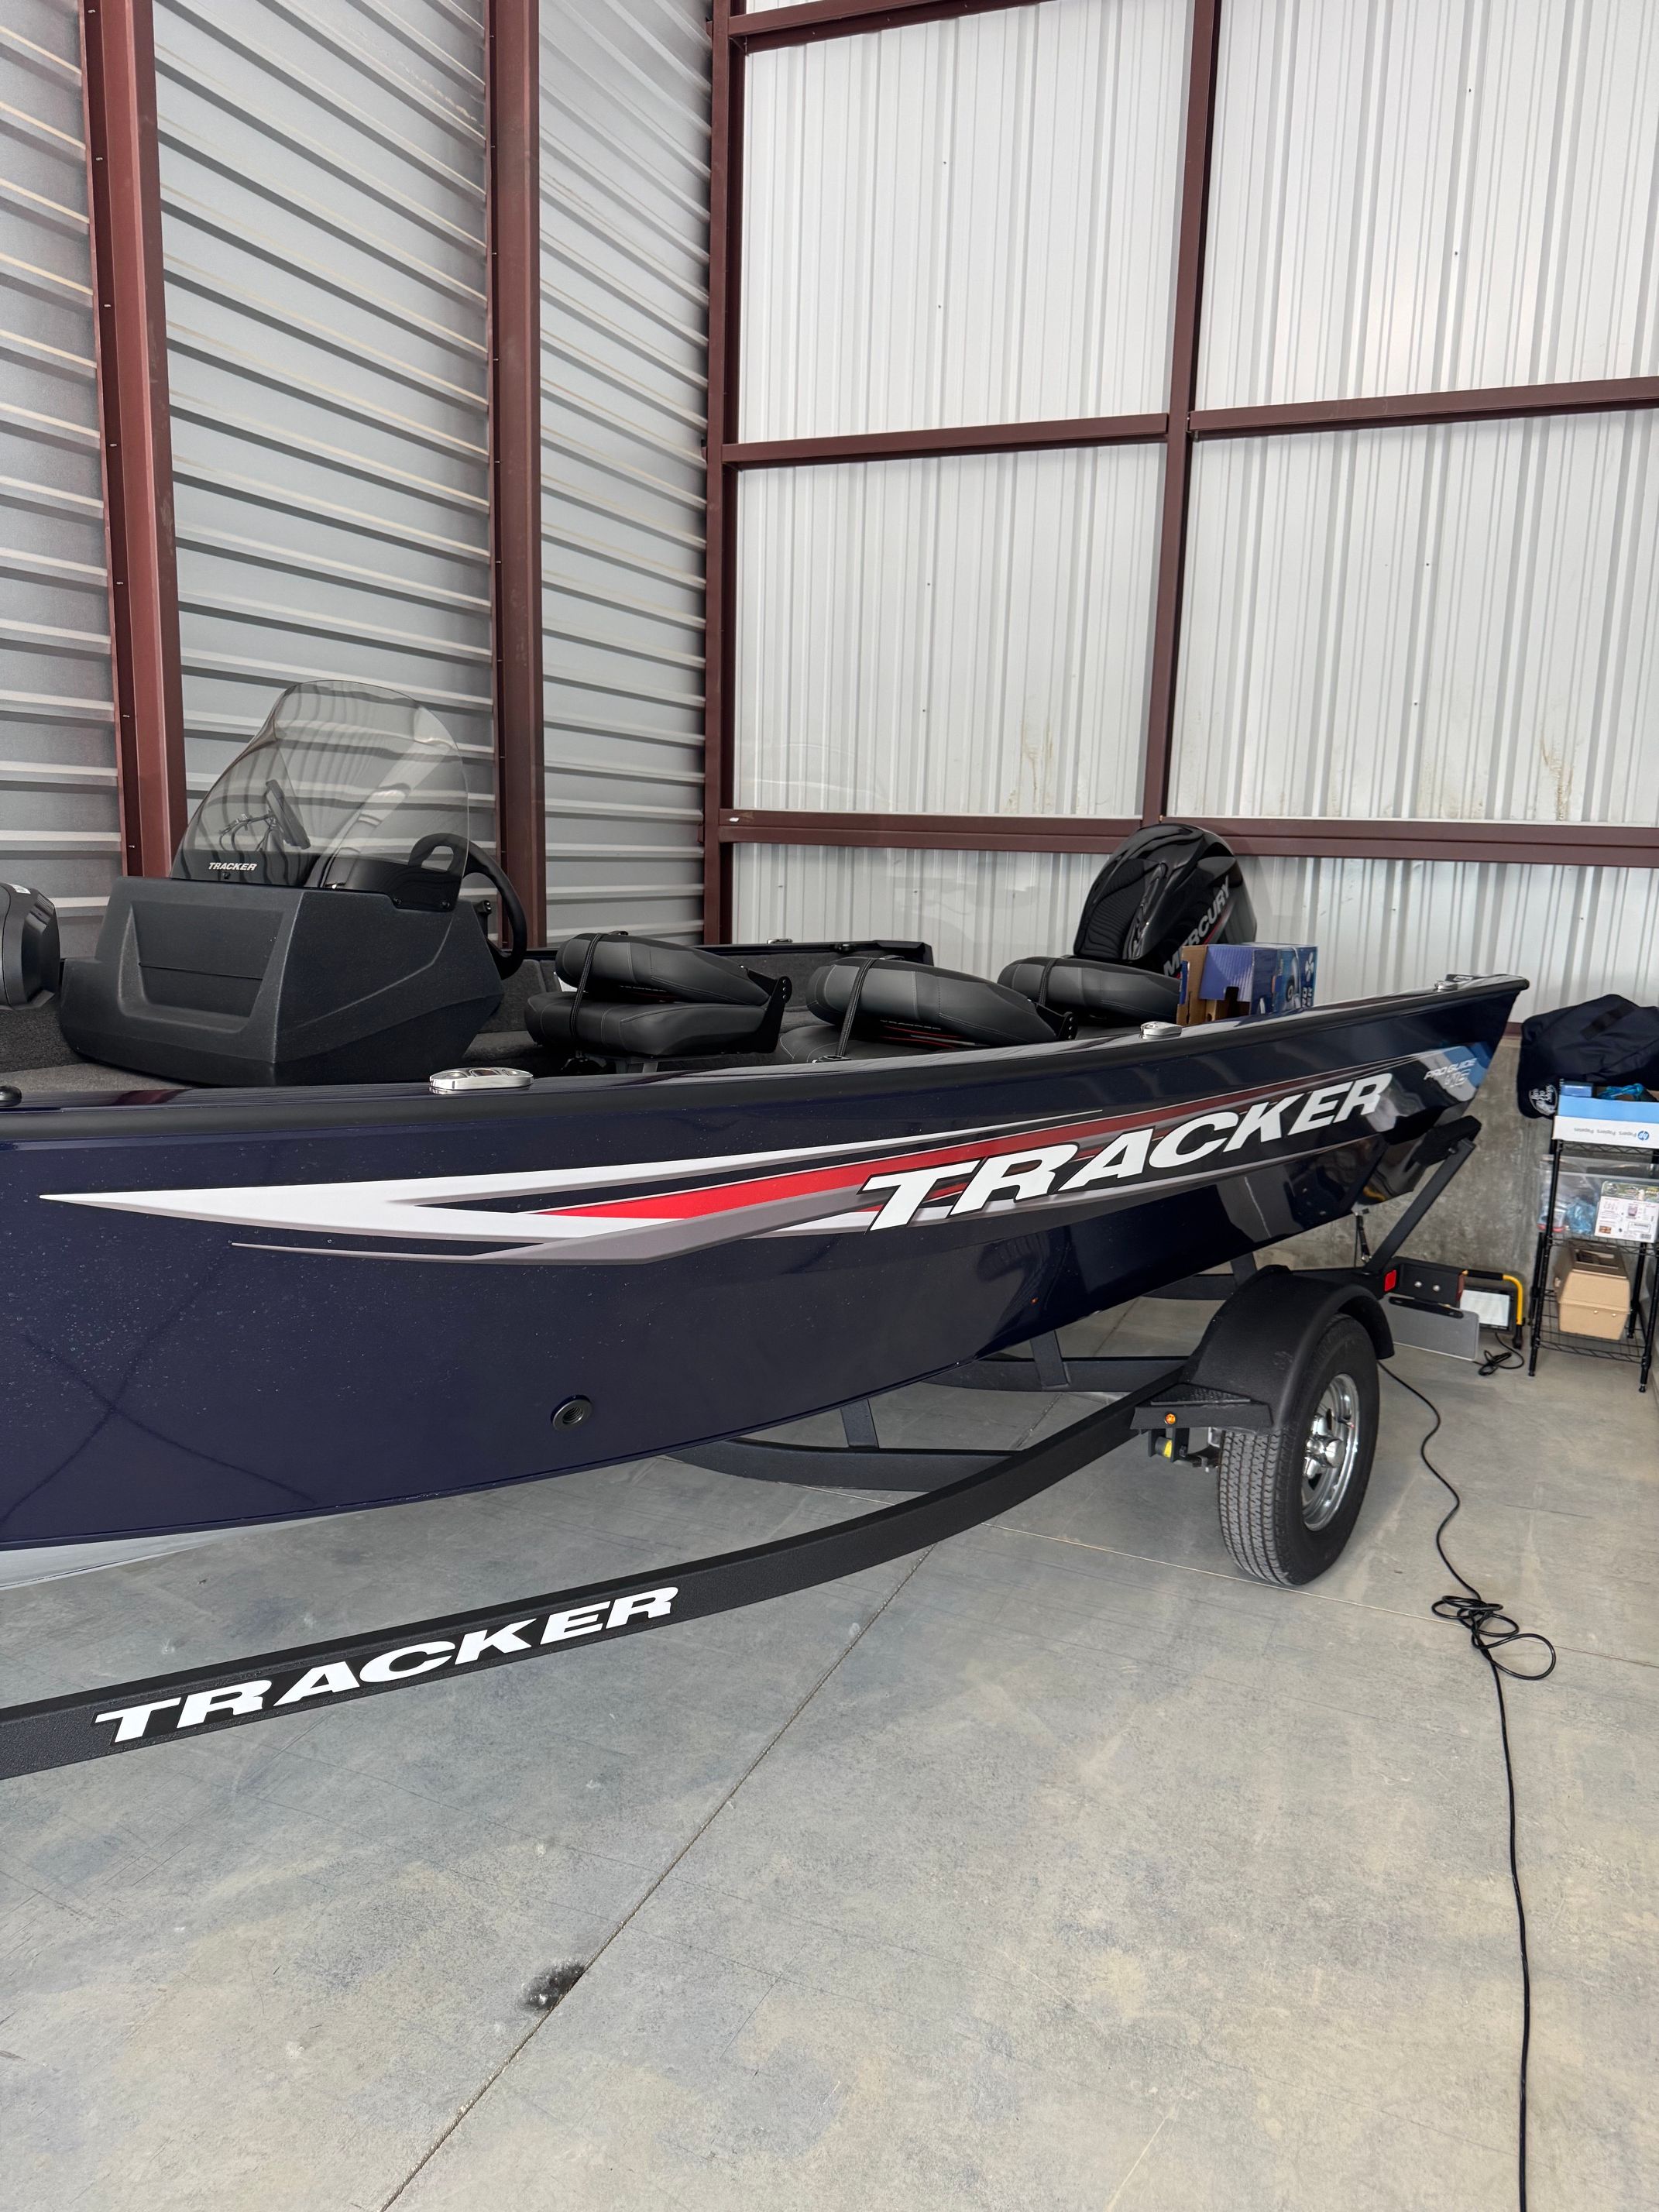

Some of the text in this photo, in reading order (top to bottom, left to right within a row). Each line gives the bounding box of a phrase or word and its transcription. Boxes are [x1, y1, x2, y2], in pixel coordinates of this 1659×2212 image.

[208, 862, 258, 871] TRACKER
[1424, 1066, 1448, 1080] PRO
[1448, 1058, 1478, 1073] GUIDE
[1637, 1130, 1650, 1141] hp
[862, 1073, 1393, 1231] TRACKER
[95, 1585, 678, 1745] TRACKER
